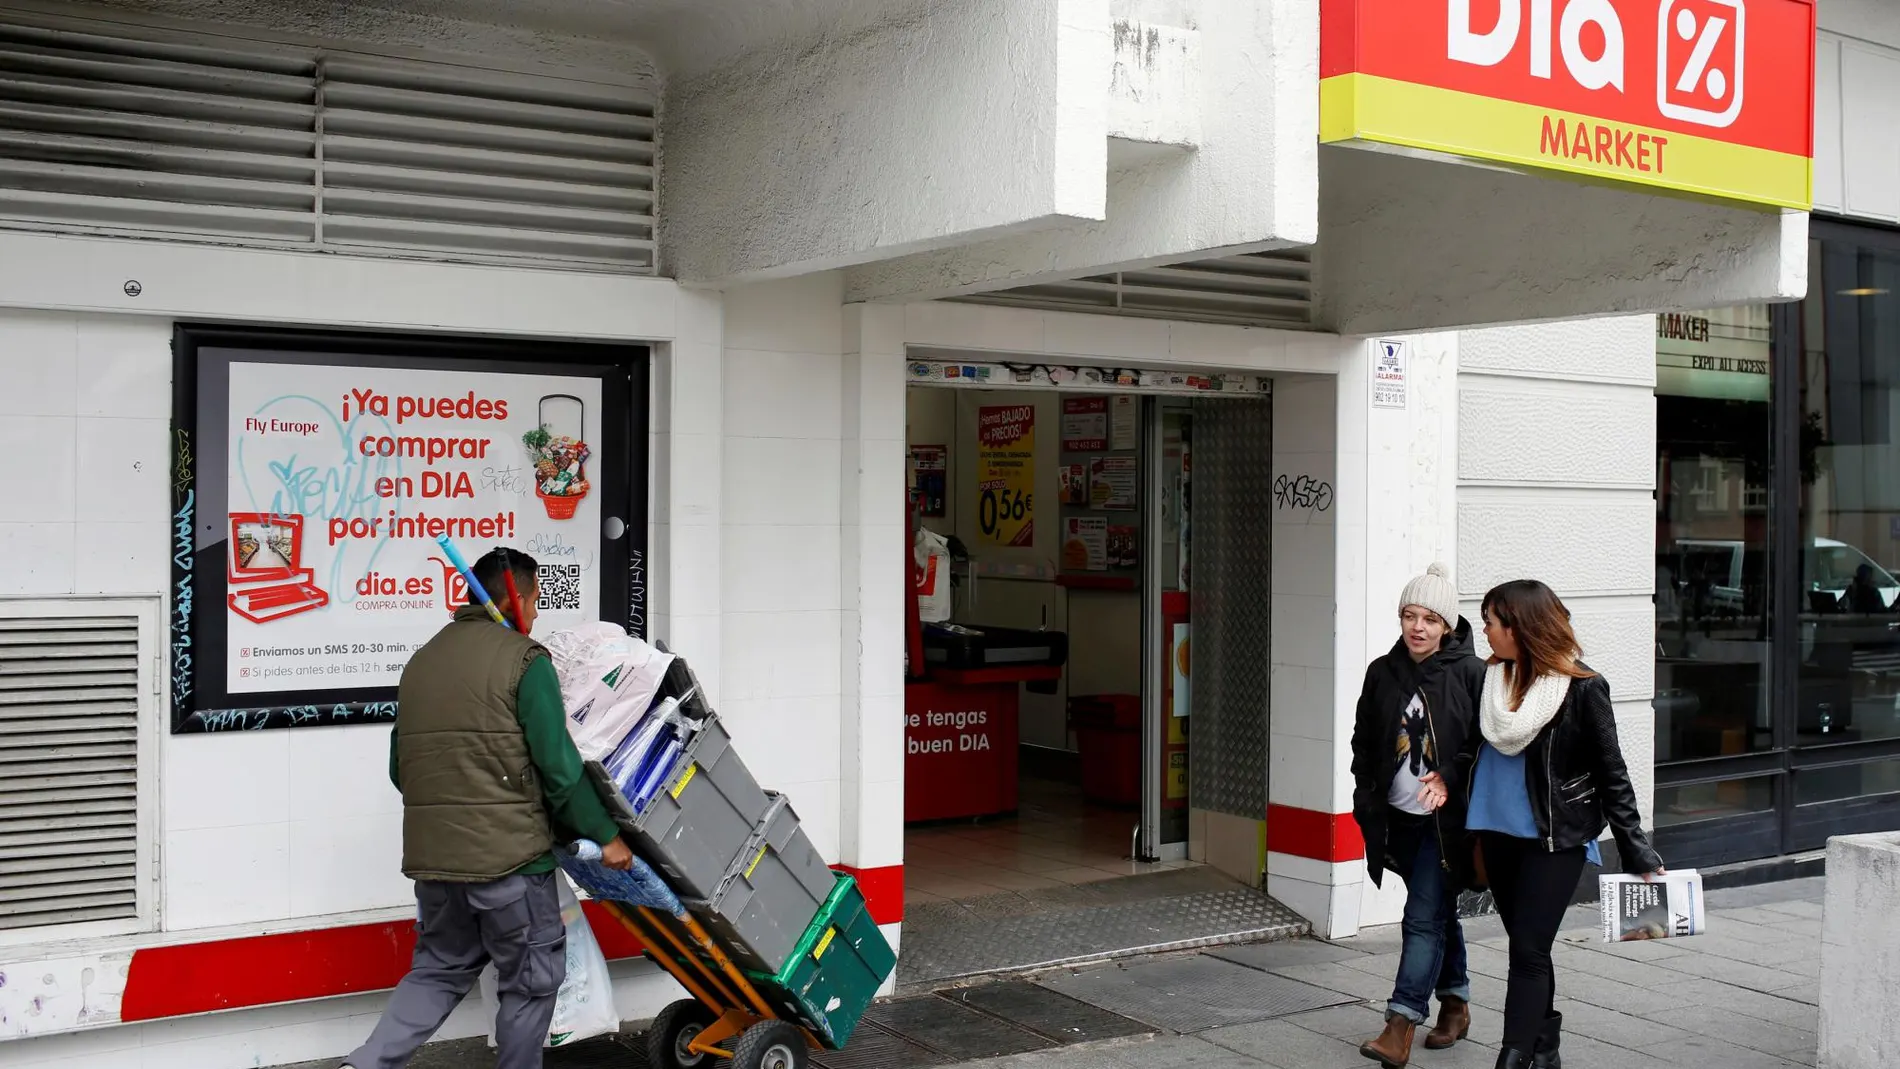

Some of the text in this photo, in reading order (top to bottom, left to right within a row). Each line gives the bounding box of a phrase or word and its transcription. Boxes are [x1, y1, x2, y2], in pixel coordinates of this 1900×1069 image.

[1540, 115, 1668, 174] MARKET
[1659, 313, 1709, 342] MAKER
[1692, 355, 1766, 375] EXPO ALL ACCESS
[343, 388, 508, 425] ¡Ya puedes
[1001, 406, 1031, 424] BAJADO
[246, 417, 319, 436] Fly Europe
[991, 423, 1022, 441] PRECIOS!
[360, 435, 491, 465] comprar
[374, 475, 413, 498] en
[421, 471, 475, 498] DIA
[328, 509, 515, 546] por internet!
[356, 571, 434, 596] dia.es
[355, 599, 434, 611] COMPRA ONLINE
[253, 646, 305, 657] Enviamos
[307, 647, 322, 656] un
[324, 644, 348, 655] SMS
[352, 643, 384, 654] 20-30
[386, 642, 409, 653] min.
[252, 667, 260, 678] Si
[264, 664, 293, 679] pides
[296, 663, 324, 676] antes
[327, 662, 341, 674] de
[343, 662, 358, 674] las
[360, 662, 371, 673] 12
[926, 709, 987, 730] tengas
[908, 733, 990, 754] buen DIA
